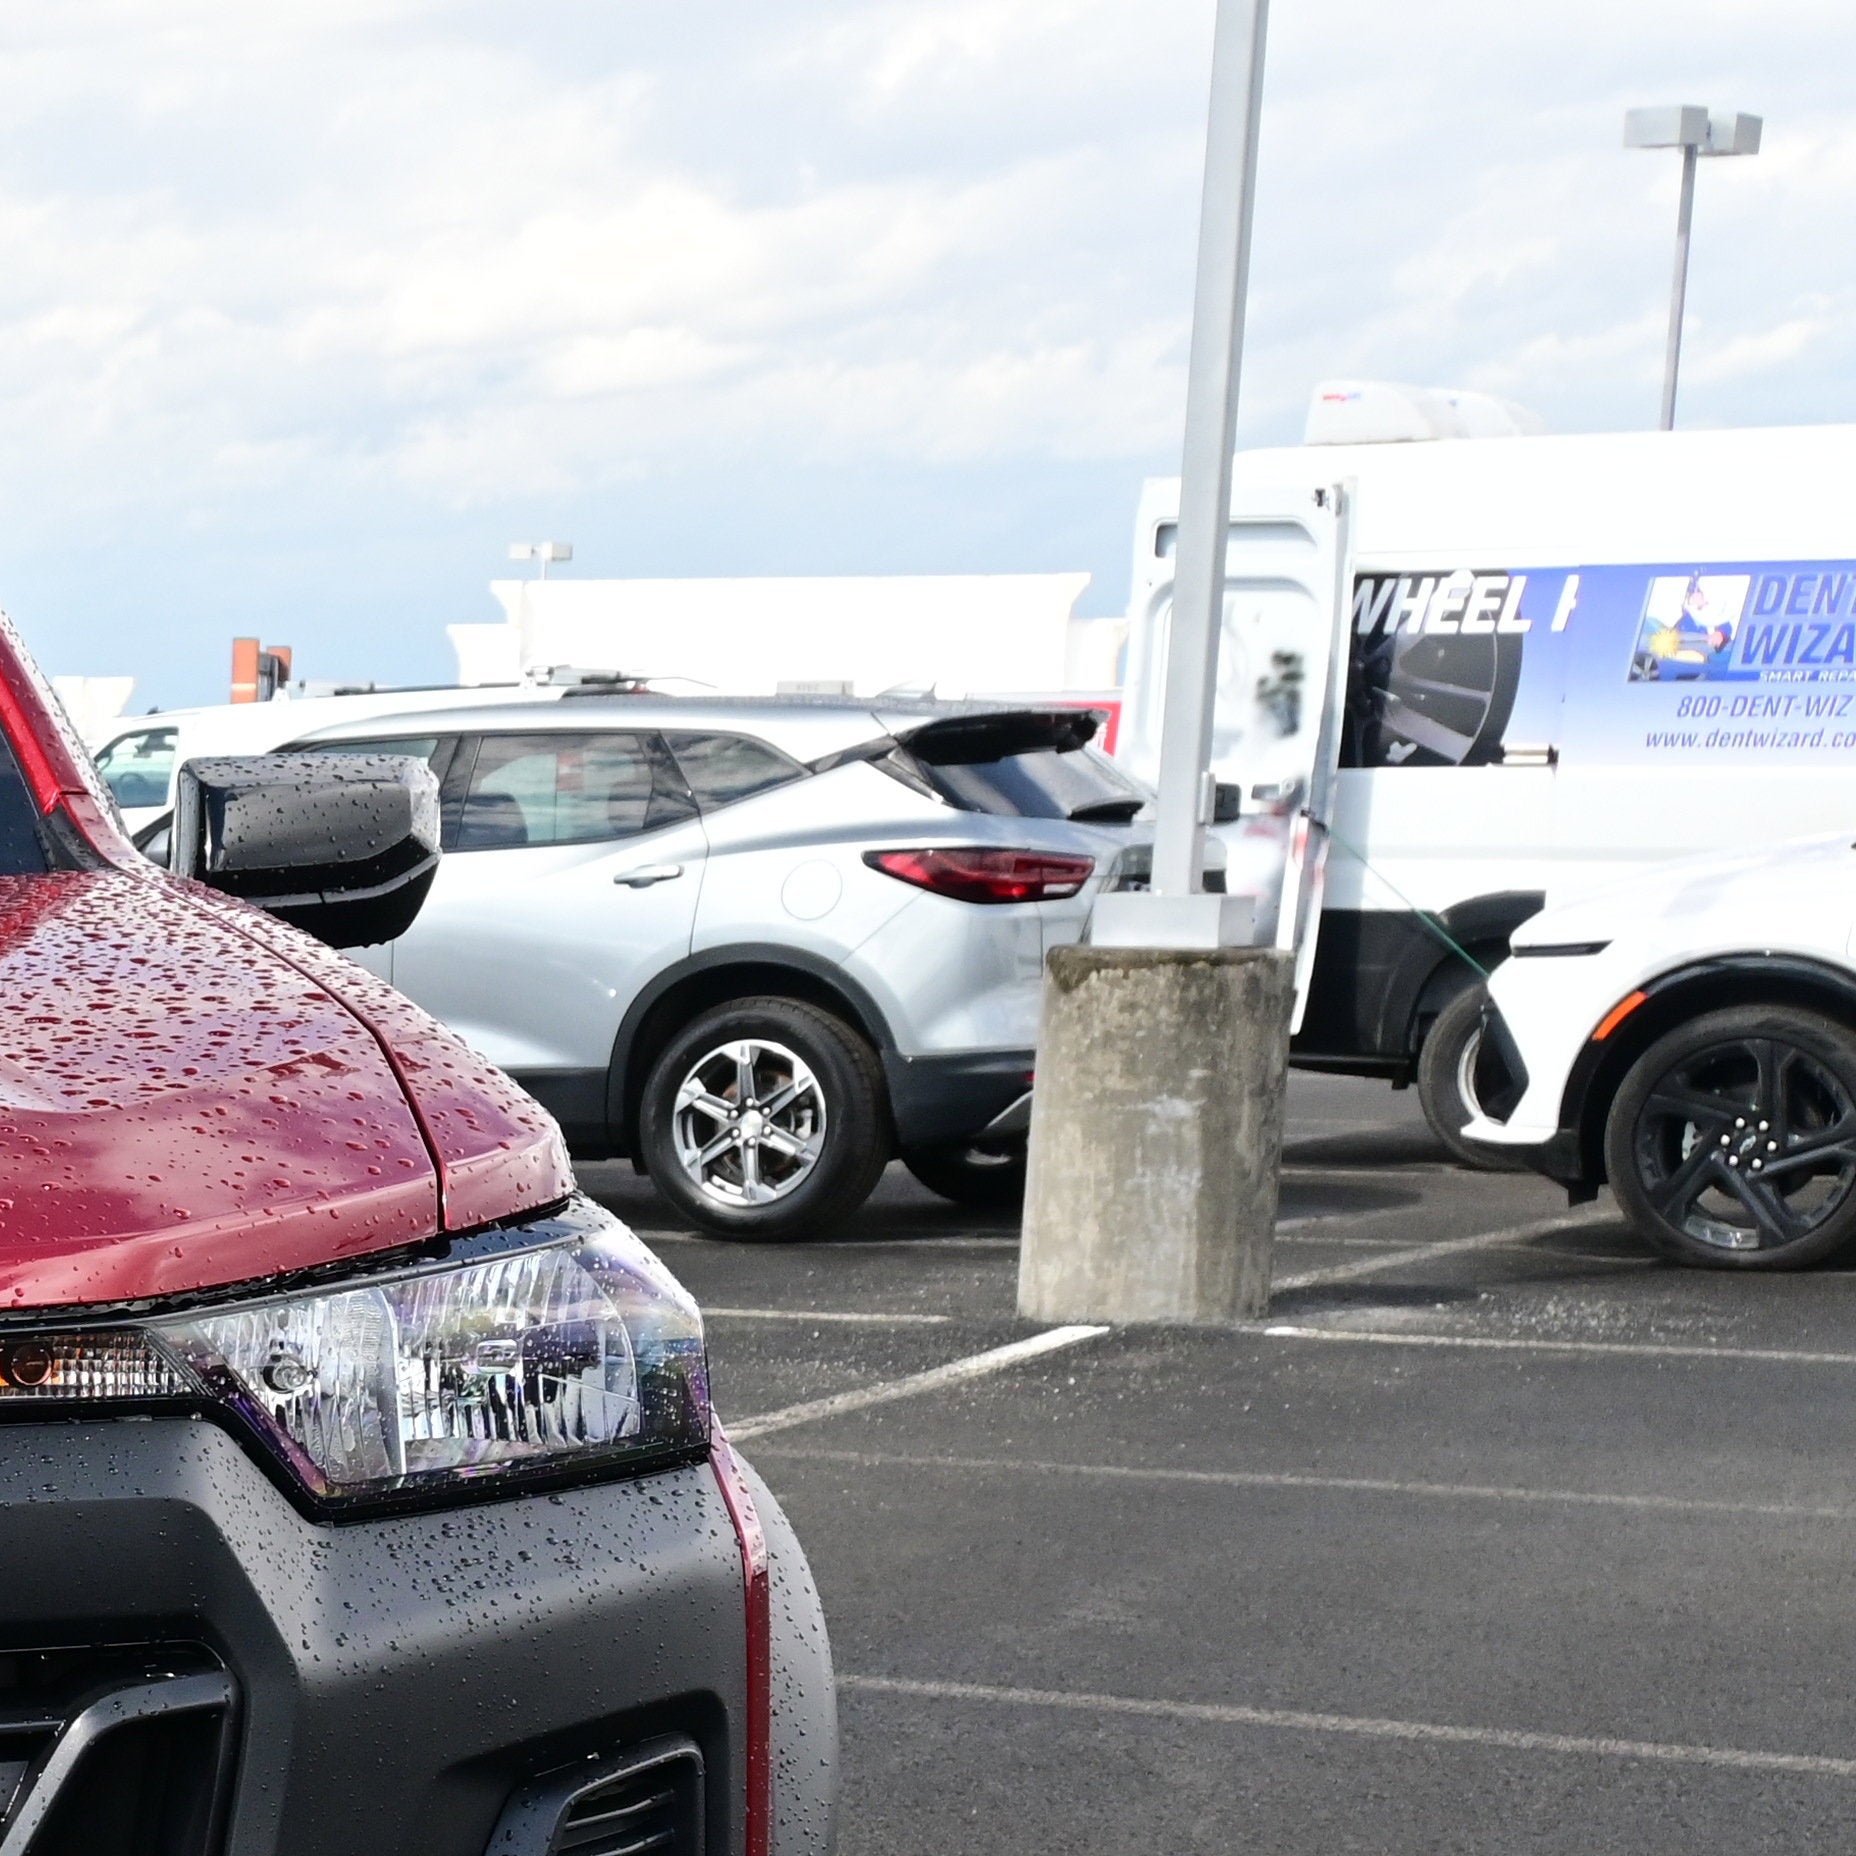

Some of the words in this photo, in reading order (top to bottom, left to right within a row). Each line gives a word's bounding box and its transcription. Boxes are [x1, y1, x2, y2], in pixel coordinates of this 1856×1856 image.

[1352, 575, 1532, 634] WHEEL
[1751, 574, 1856, 617] DEN
[1759, 670, 1812, 682] SMART
[1676, 695, 1854, 717] 800-DENT-WIZ
